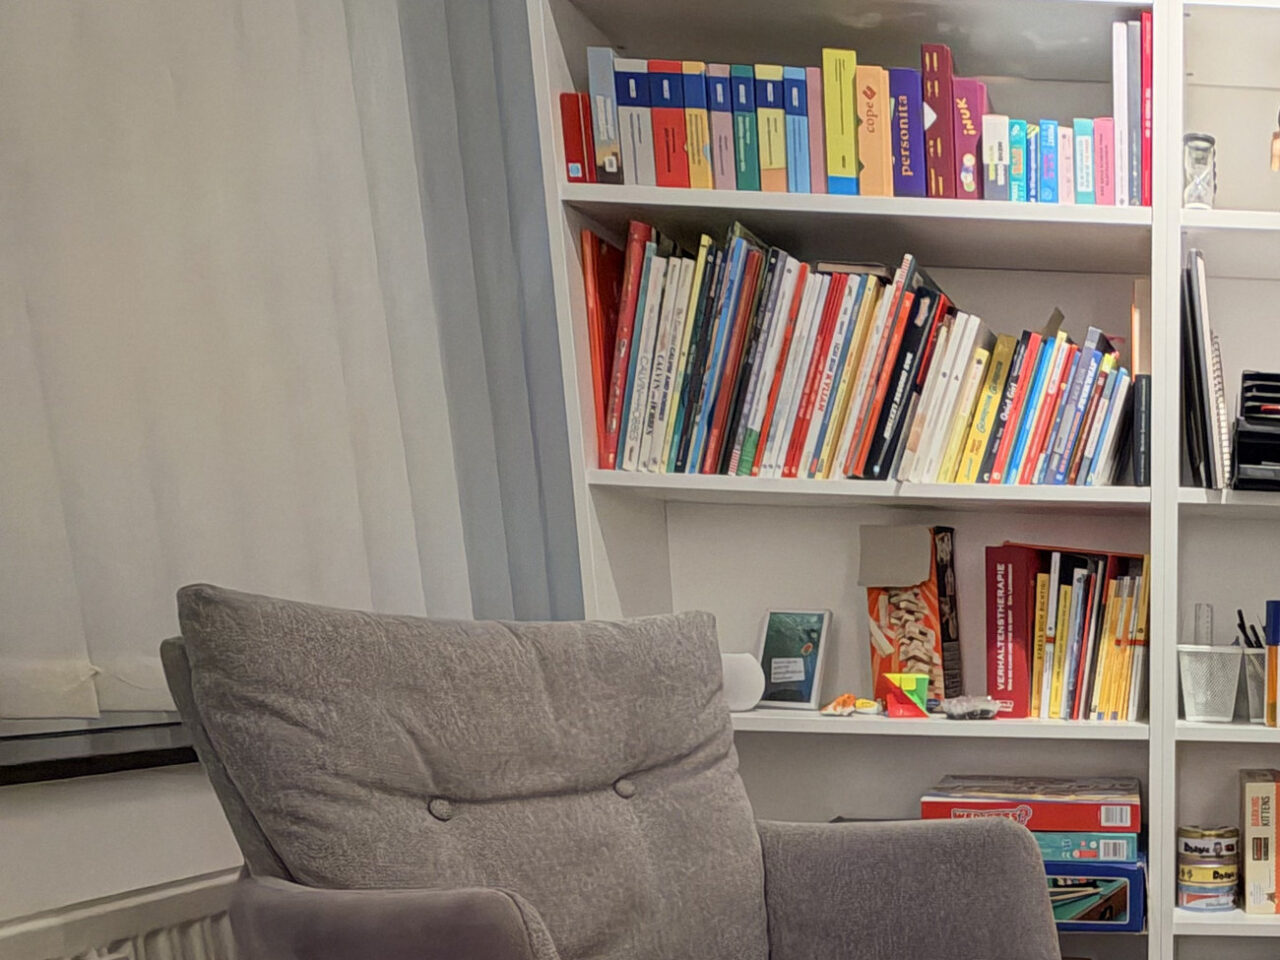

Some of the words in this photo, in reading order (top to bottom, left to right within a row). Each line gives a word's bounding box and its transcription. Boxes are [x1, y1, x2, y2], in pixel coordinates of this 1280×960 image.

[864, 101, 877, 133] cope
[896, 95, 913, 175] personita
[1005, 381, 1017, 399] Girl
[996, 562, 1004, 690] VERHALTENSTHERAPIE
[1261, 795, 1269, 826] KITTENS
